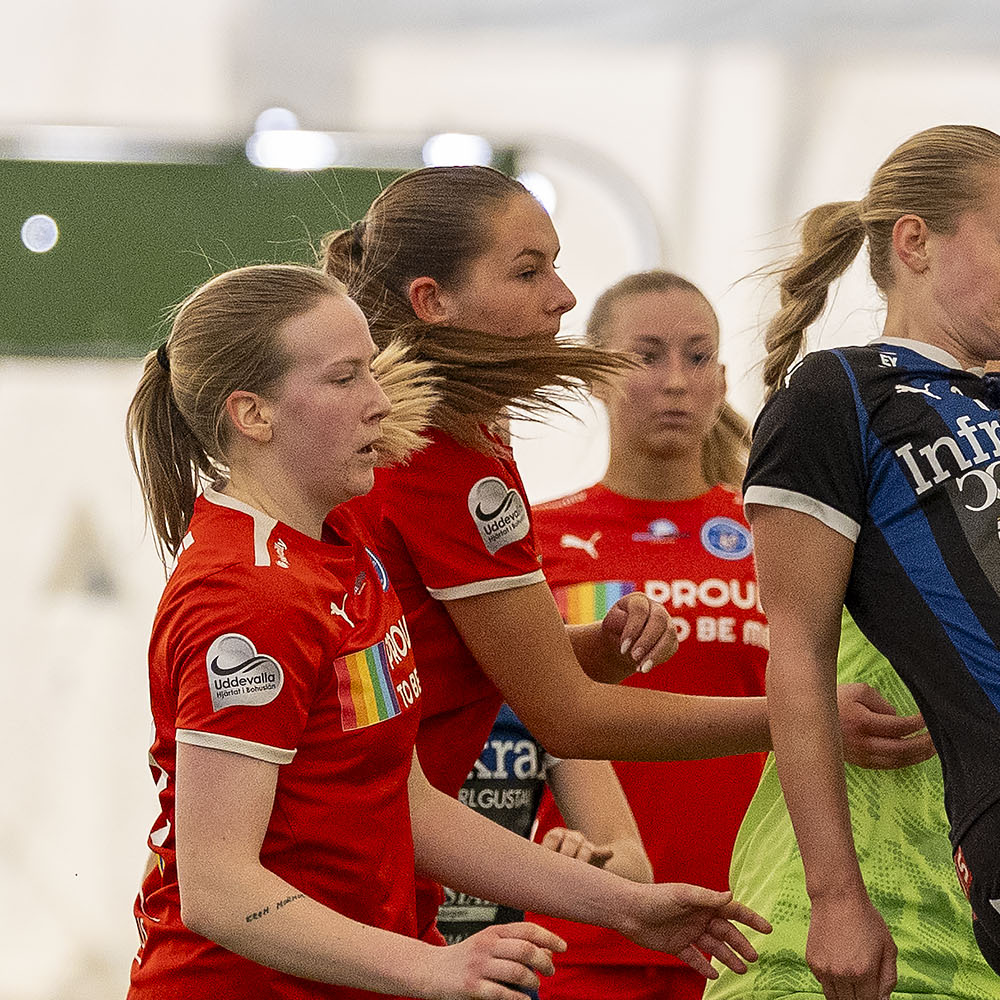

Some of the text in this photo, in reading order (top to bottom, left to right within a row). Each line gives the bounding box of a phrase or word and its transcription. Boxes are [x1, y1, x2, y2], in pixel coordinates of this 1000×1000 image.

[697, 616, 736, 643] BE
[214, 672, 276, 690] Uddevalla
[397, 680, 413, 708] TO
